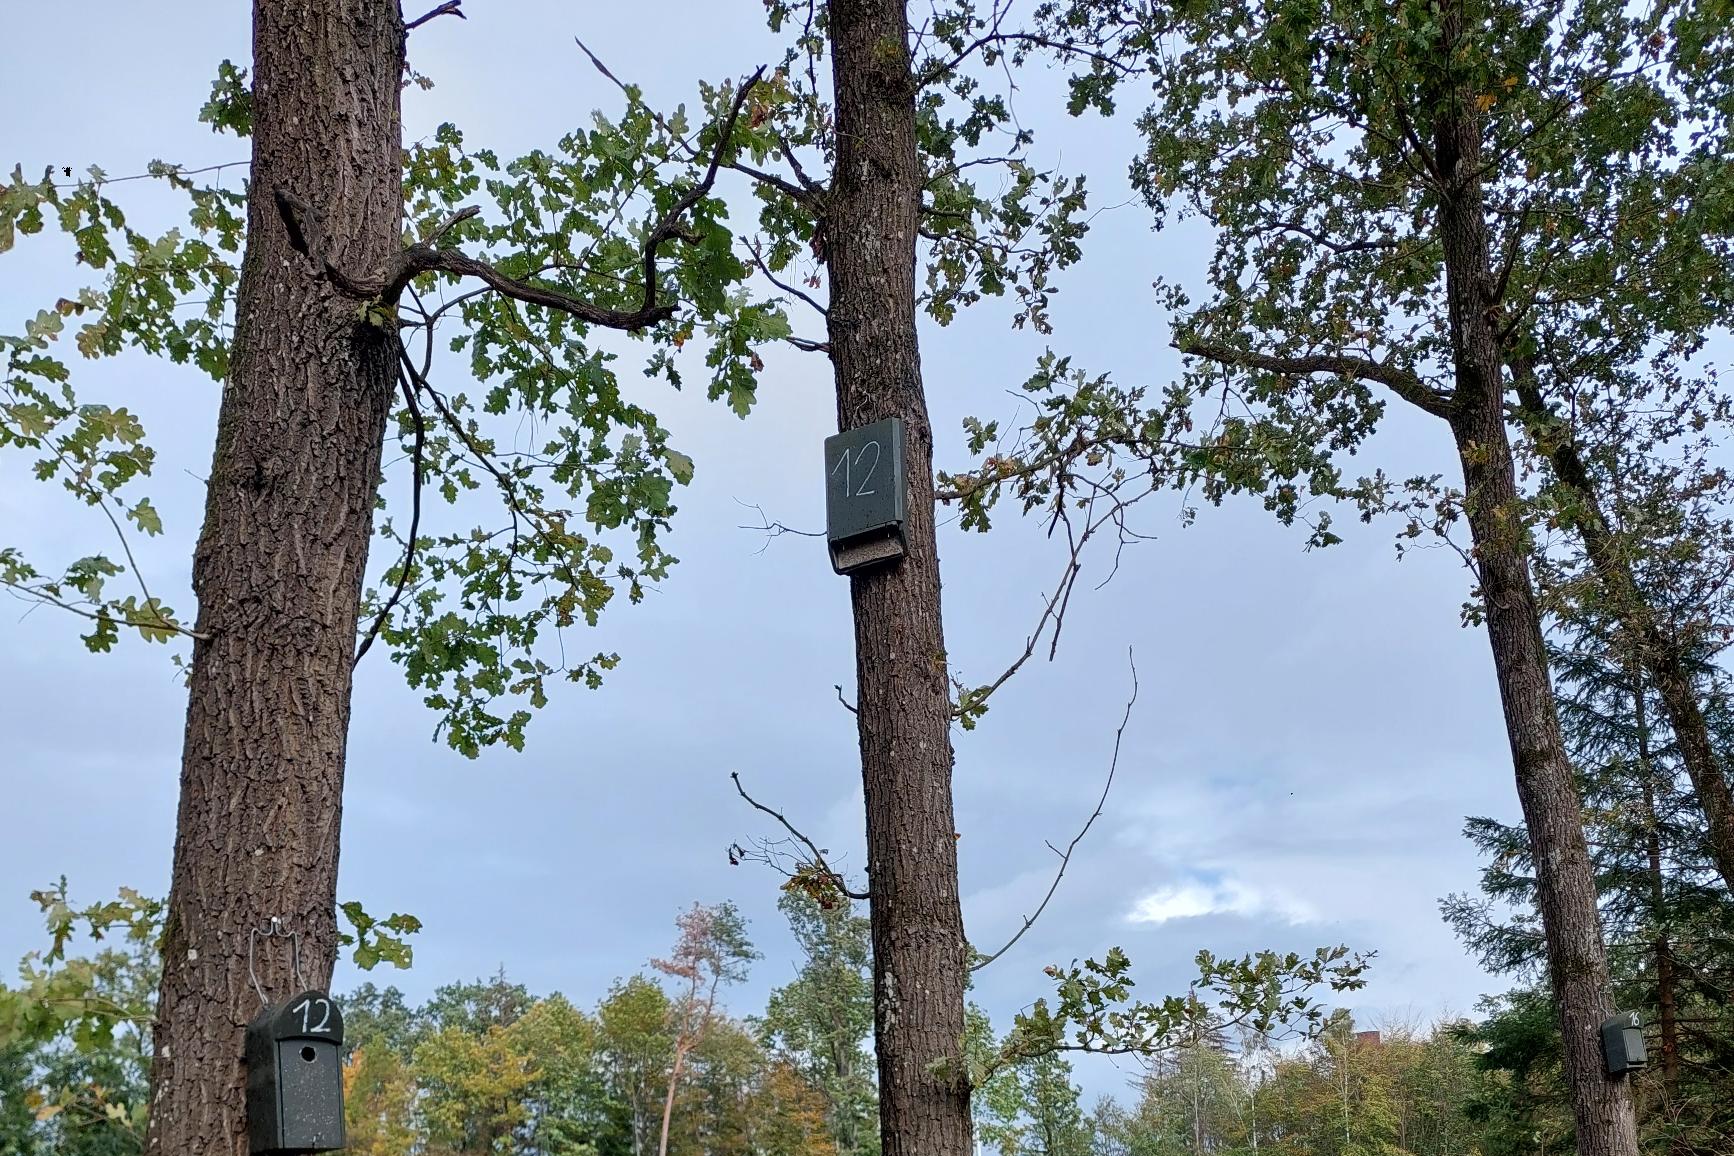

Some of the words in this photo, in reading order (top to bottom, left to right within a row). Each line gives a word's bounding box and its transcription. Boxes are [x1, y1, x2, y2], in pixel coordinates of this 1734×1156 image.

[832, 440, 881, 498] 12
[292, 998, 331, 1033] 12
[1629, 1011, 1640, 1027] 16
